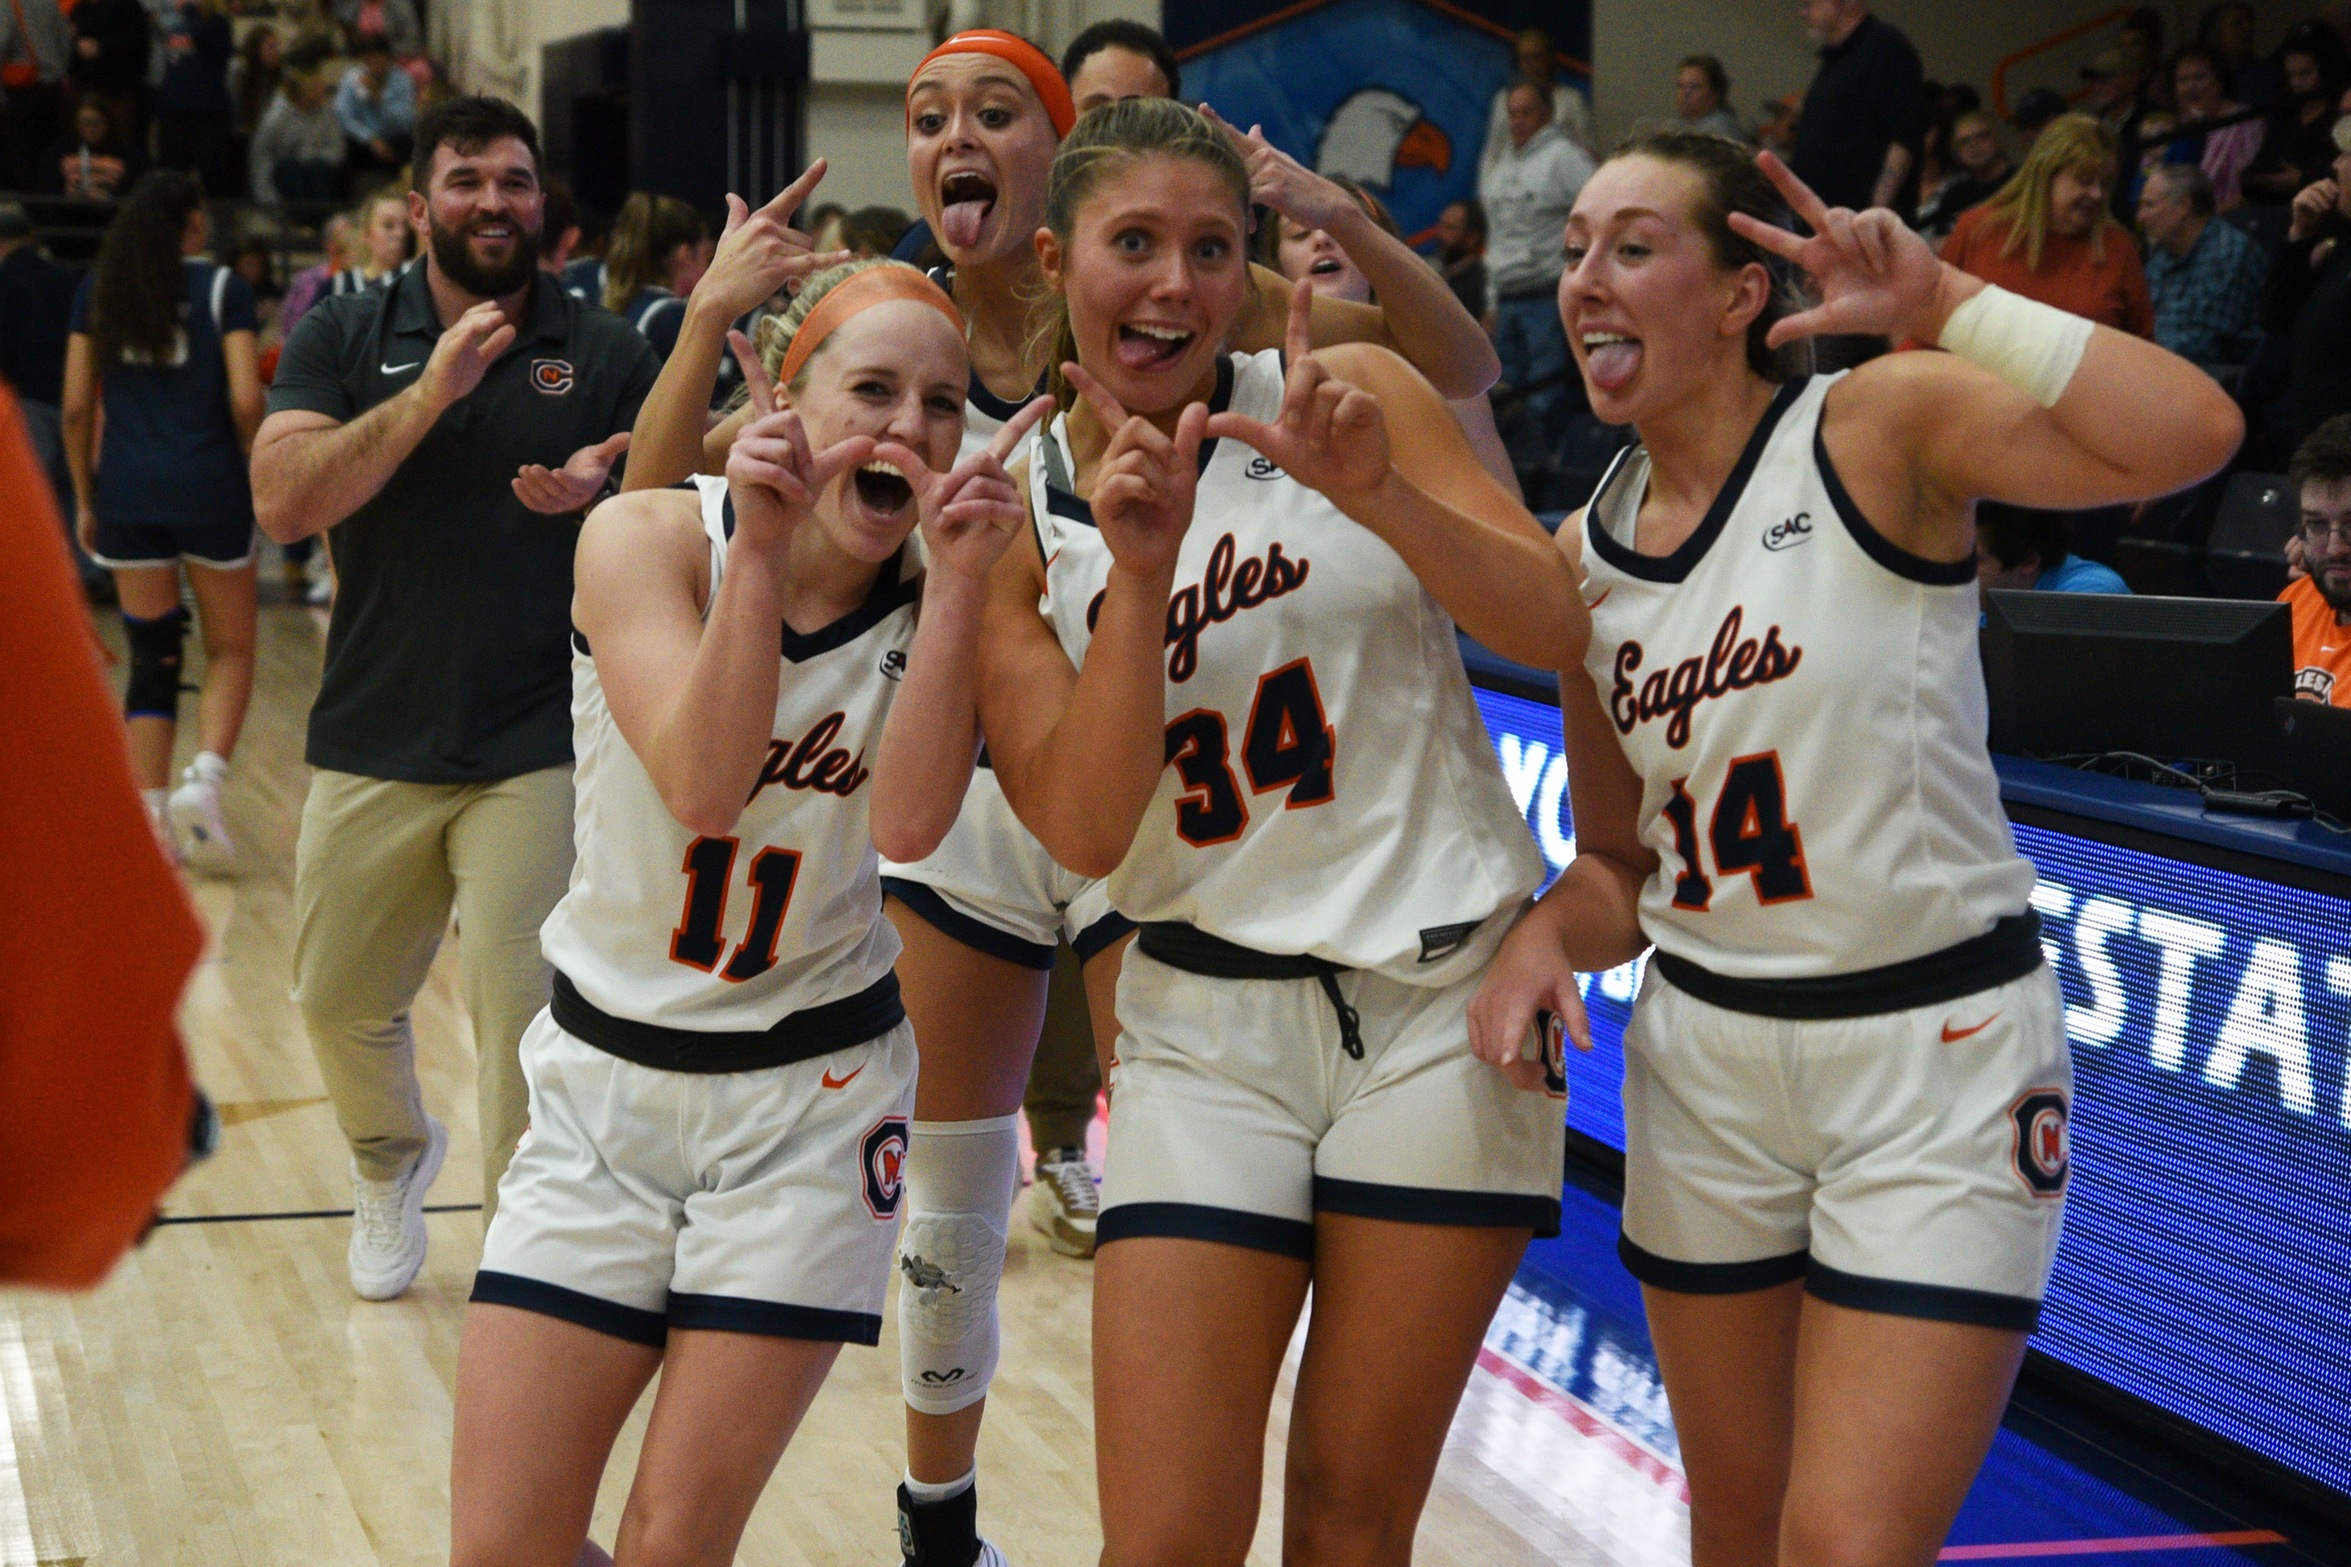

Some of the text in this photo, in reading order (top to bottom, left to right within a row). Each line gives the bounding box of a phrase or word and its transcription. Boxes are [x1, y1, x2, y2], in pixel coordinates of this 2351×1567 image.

[1770, 512, 1813, 546] SAC
[1611, 604, 1803, 750] Eagles
[1163, 656, 1336, 849] 34
[1662, 749, 1815, 913] 14
[669, 834, 803, 984] 11
